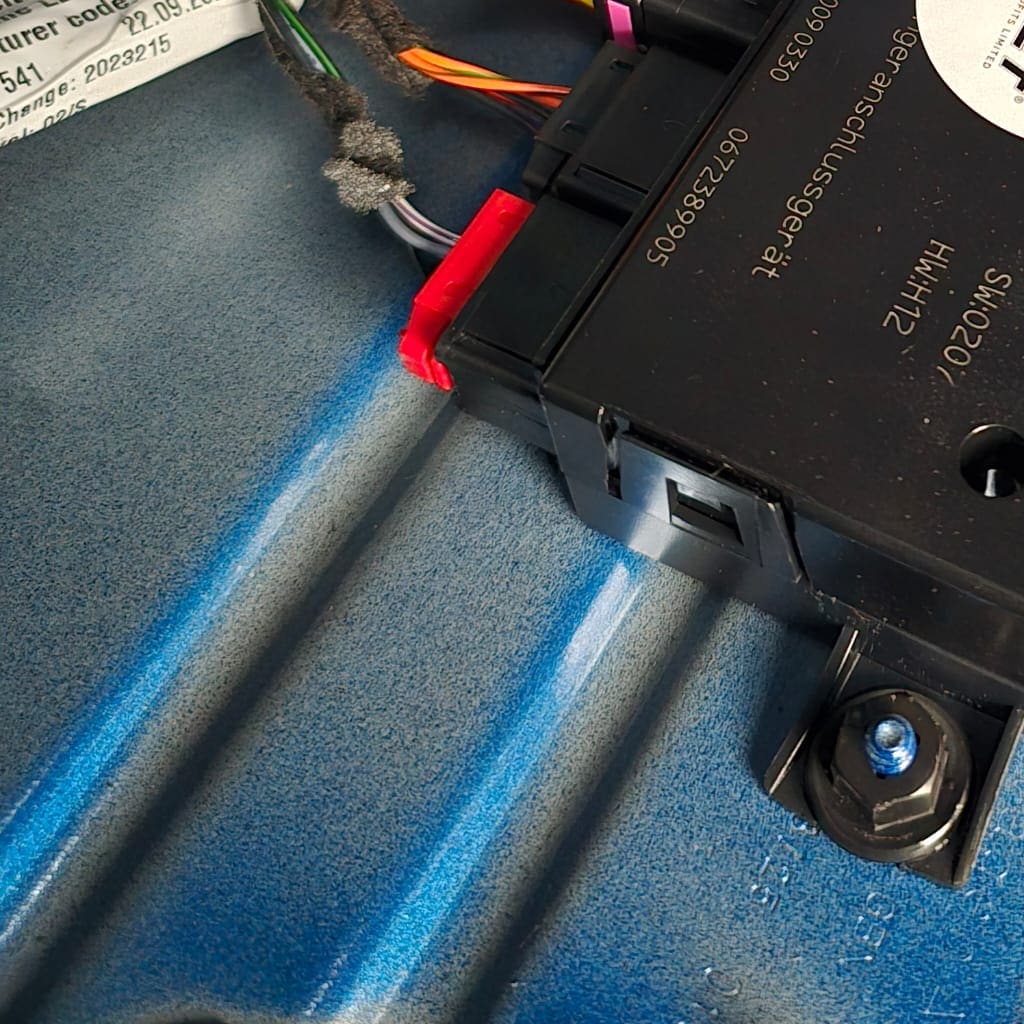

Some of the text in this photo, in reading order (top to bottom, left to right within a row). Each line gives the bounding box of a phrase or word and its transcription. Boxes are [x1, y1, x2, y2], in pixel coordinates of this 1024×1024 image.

[84, 32, 172, 84] 2023215
[981, 27, 1011, 69] LIMITED
[751, 15, 918, 278] geranschlussgerät
[645, 127, 748, 267] 0672389905
[881, 238, 955, 335] HW:H12
